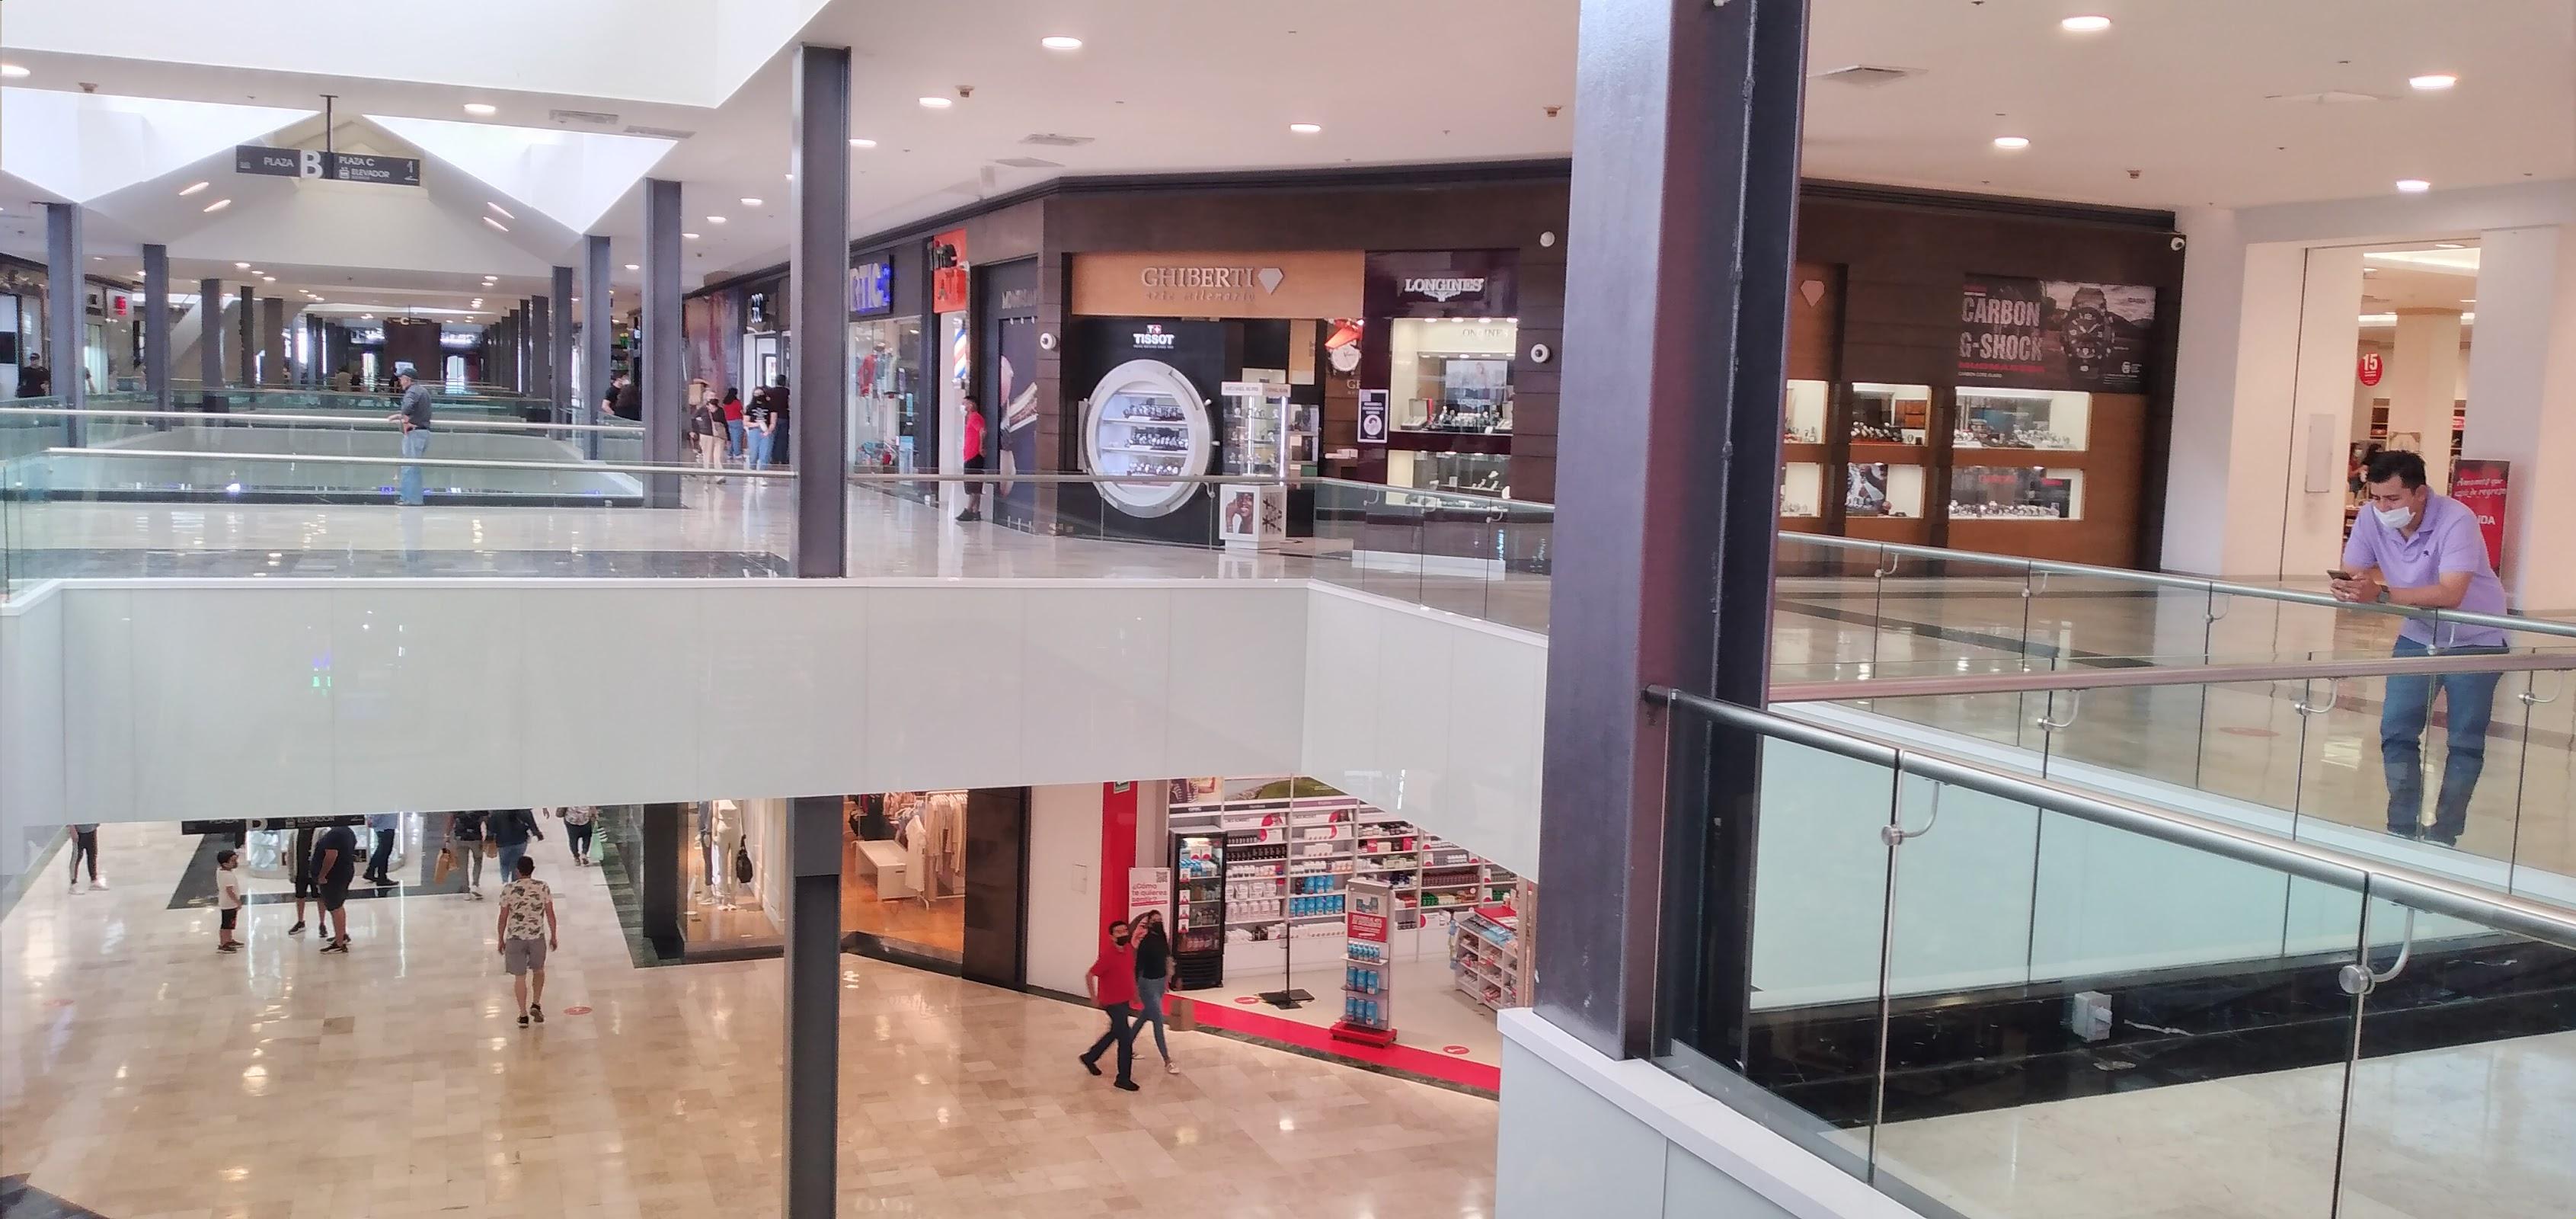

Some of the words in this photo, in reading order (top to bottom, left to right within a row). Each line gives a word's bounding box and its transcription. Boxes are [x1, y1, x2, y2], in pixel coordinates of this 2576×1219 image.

[264, 157, 295, 167] PLAZA
[301, 150, 324, 179] B
[338, 156, 365, 166] PLAZA
[366, 158, 375, 167] C
[351, 168, 391, 178] ELEVADOR
[1142, 267, 1254, 287] GHIBERTI
[1405, 278, 1485, 292] LONGINES
[1962, 296, 2041, 327] CARBON
[1133, 334, 1175, 345] TISSOT
[1959, 331, 2044, 362] G-SHOCK
[2363, 354, 2378, 370] 15
